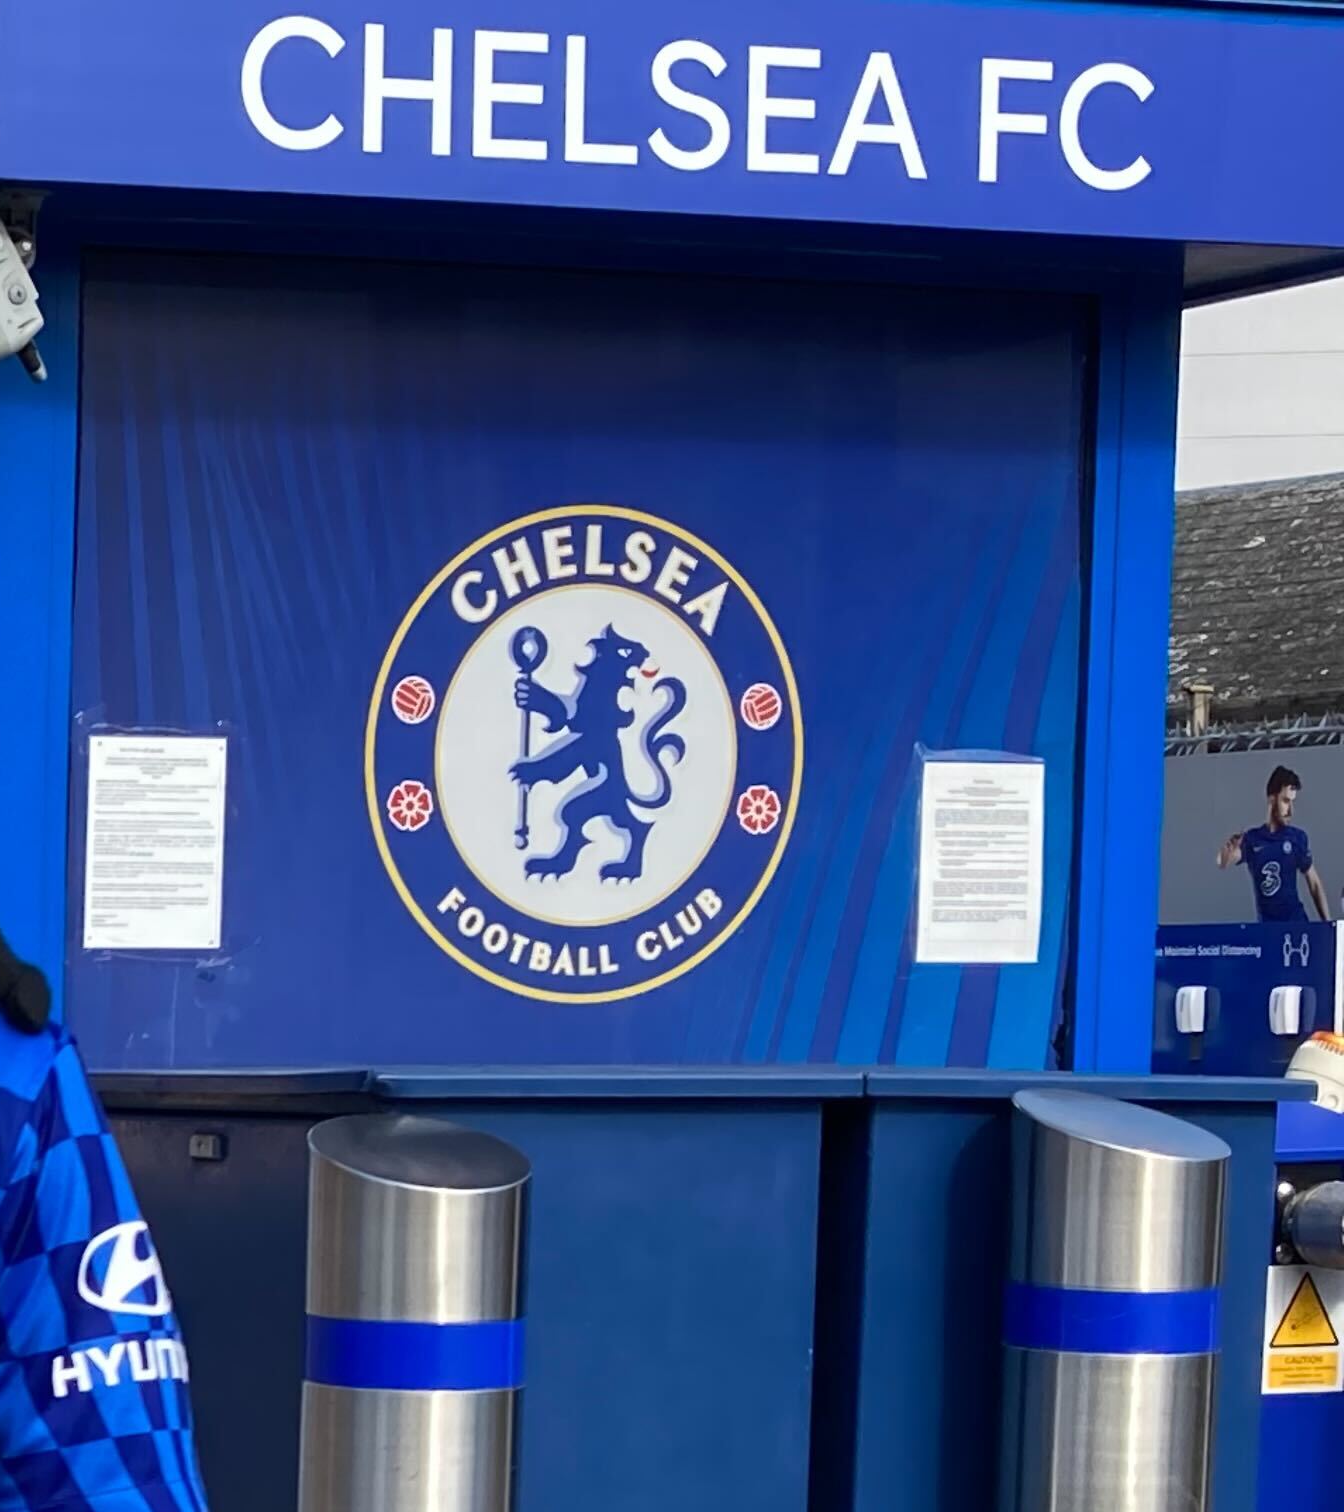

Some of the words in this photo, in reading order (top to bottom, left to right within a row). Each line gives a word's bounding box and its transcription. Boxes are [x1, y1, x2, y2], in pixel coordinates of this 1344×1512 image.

[240, 13, 928, 182] CHELSEA
[976, 57, 1156, 192] FC
[450, 523, 731, 637] CHELSEA
[436, 886, 620, 977] FOOTBALL
[634, 886, 724, 962] CLUB
[1198, 944, 1220, 957] Social
[1222, 944, 1262, 959] Distancing
[52, 1337, 190, 1398] HYUN
